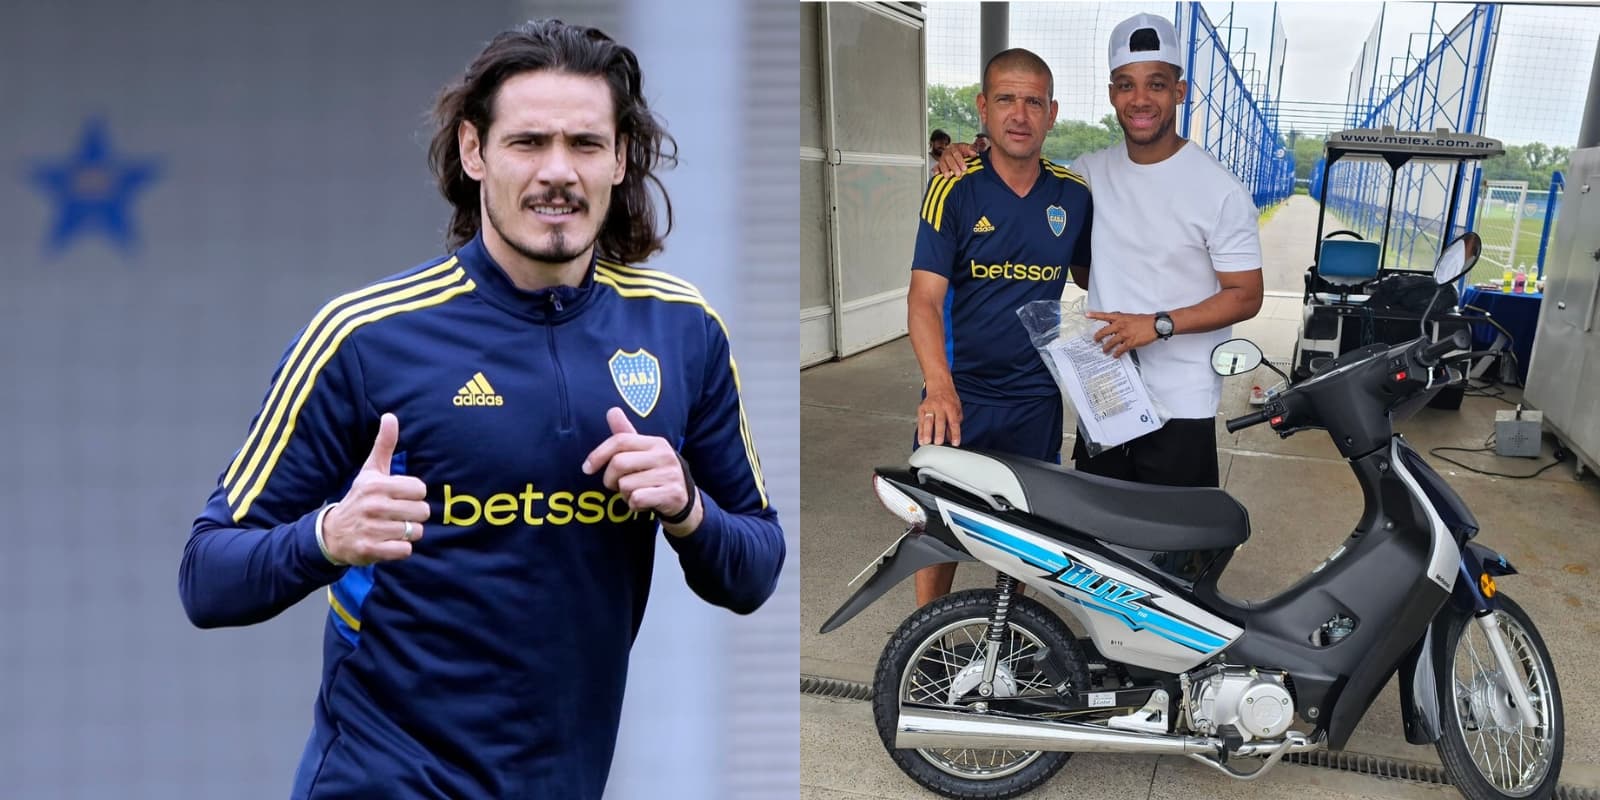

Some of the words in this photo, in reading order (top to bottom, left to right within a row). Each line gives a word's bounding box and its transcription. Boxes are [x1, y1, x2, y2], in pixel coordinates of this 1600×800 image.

[1340, 133, 1493, 149] www.melex.com.ar
[971, 260, 1061, 281] betsson
[618, 372, 655, 386] CABJ
[453, 393, 503, 406] adidas
